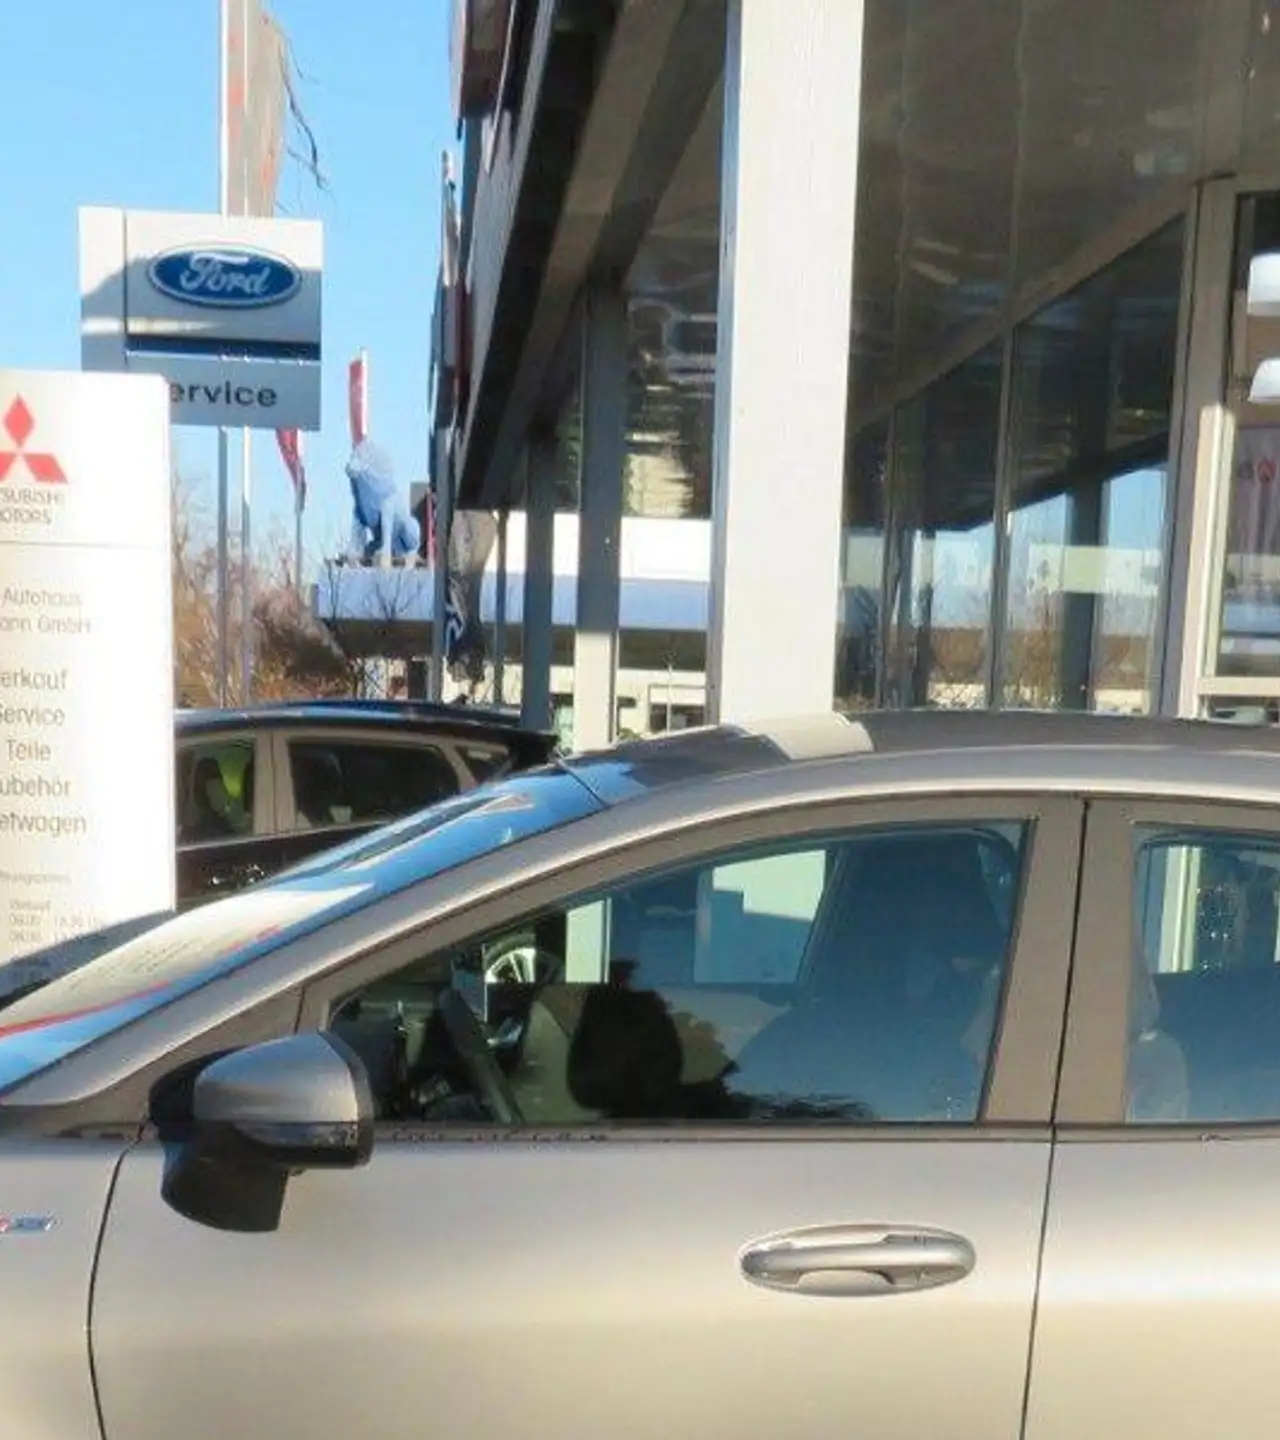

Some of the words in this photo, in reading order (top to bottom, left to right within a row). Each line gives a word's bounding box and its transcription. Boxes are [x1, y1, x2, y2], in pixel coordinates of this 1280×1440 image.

[179, 251, 270, 295] Ford
[169, 380, 278, 408] ervice
[3, 587, 83, 607] Autohaus
[37, 615, 93, 635] GmbH
[6, 738, 51, 762] Teile
